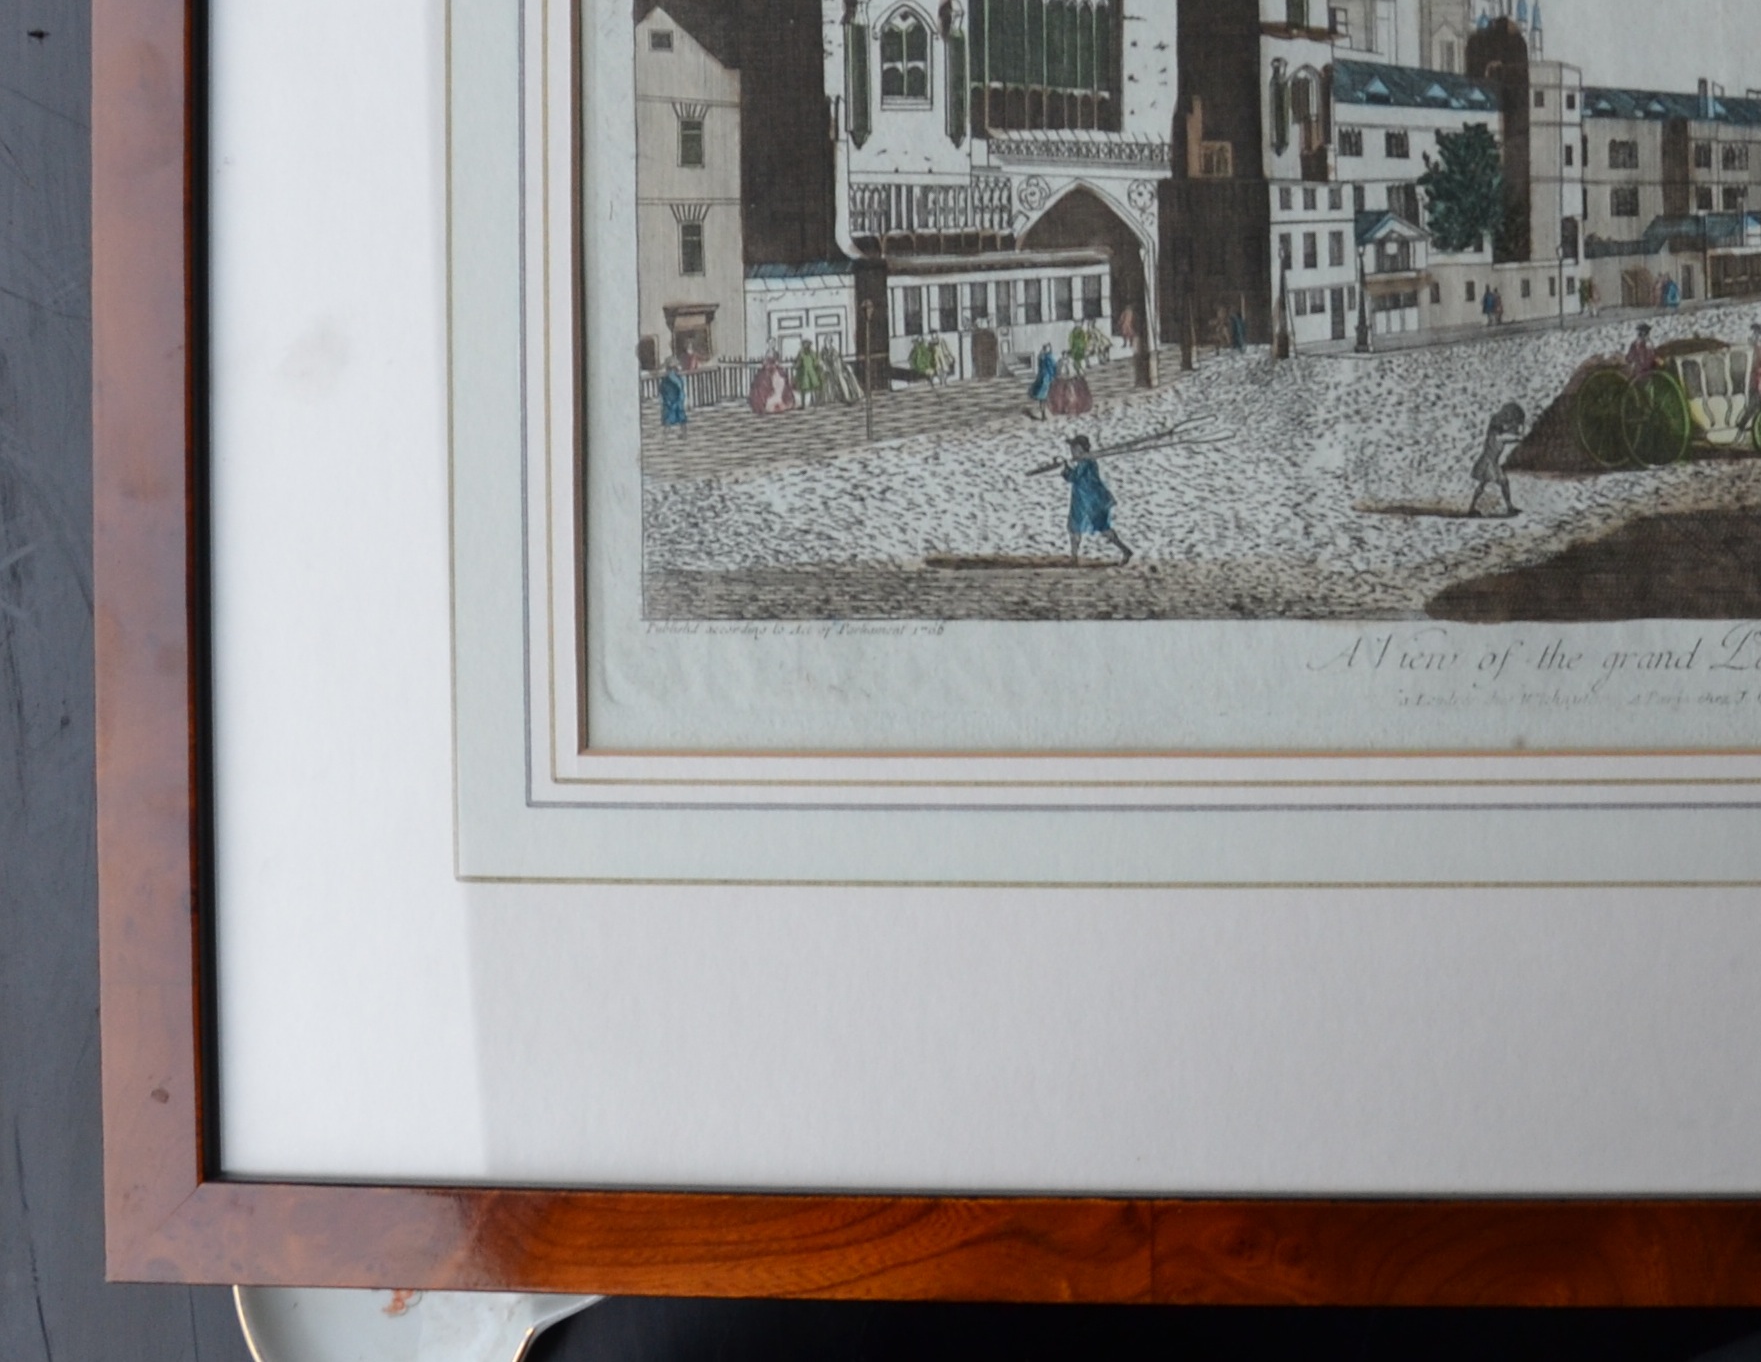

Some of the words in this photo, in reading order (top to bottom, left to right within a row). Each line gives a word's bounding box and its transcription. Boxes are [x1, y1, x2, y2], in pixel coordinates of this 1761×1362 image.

[1473, 639, 1525, 688] of
[1536, 636, 1584, 672] the
[1591, 636, 1703, 693] grand
